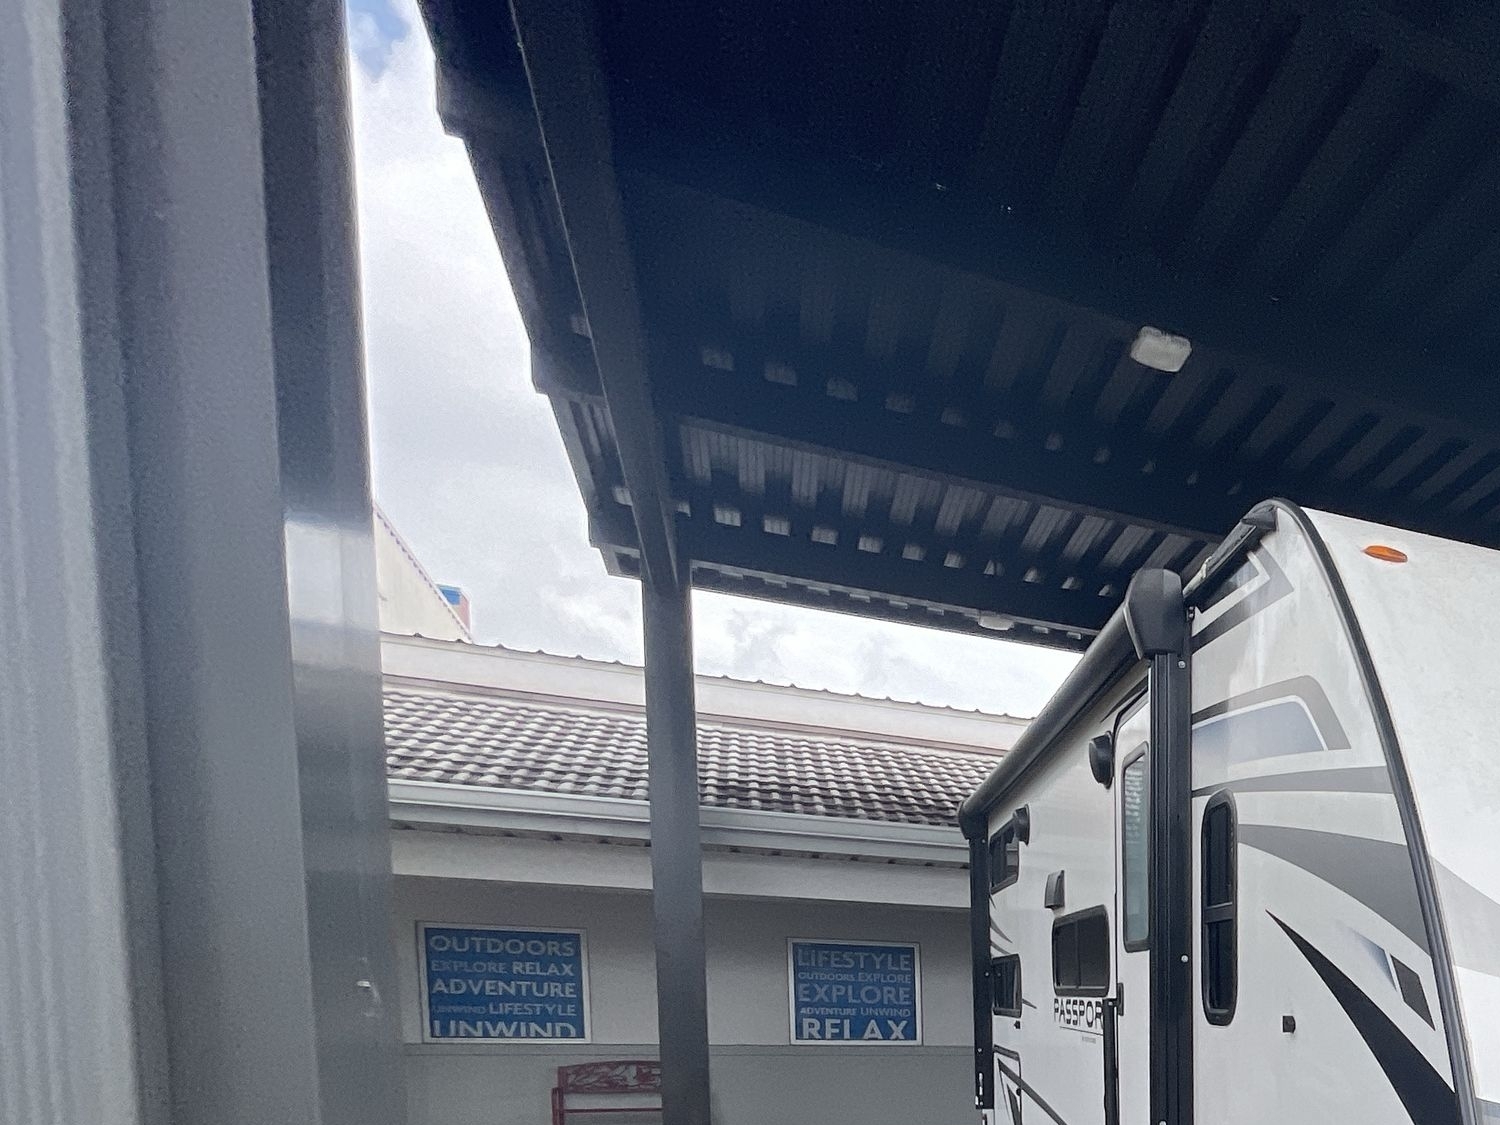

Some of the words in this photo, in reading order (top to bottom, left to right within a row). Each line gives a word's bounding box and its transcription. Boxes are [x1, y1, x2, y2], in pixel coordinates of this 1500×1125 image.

[429, 935, 575, 957] OUTDOORS
[431, 960, 508, 974] EXPLORE
[512, 961, 574, 976] RELAX
[798, 949, 912, 971] LIFESTYLE
[798, 971, 855, 981] OUTDOORS
[858, 972, 911, 984] EXPLORE
[432, 978, 577, 998] ADVENTURE
[798, 983, 912, 1005] EXPLORE
[489, 1002, 577, 1017] LIFESTYLE
[800, 1006, 858, 1016] ADVENTURE
[861, 1007, 911, 1017] UNWIND
[1054, 998, 1103, 1030] PASSPOR
[433, 1020, 577, 1038] UNWIND
